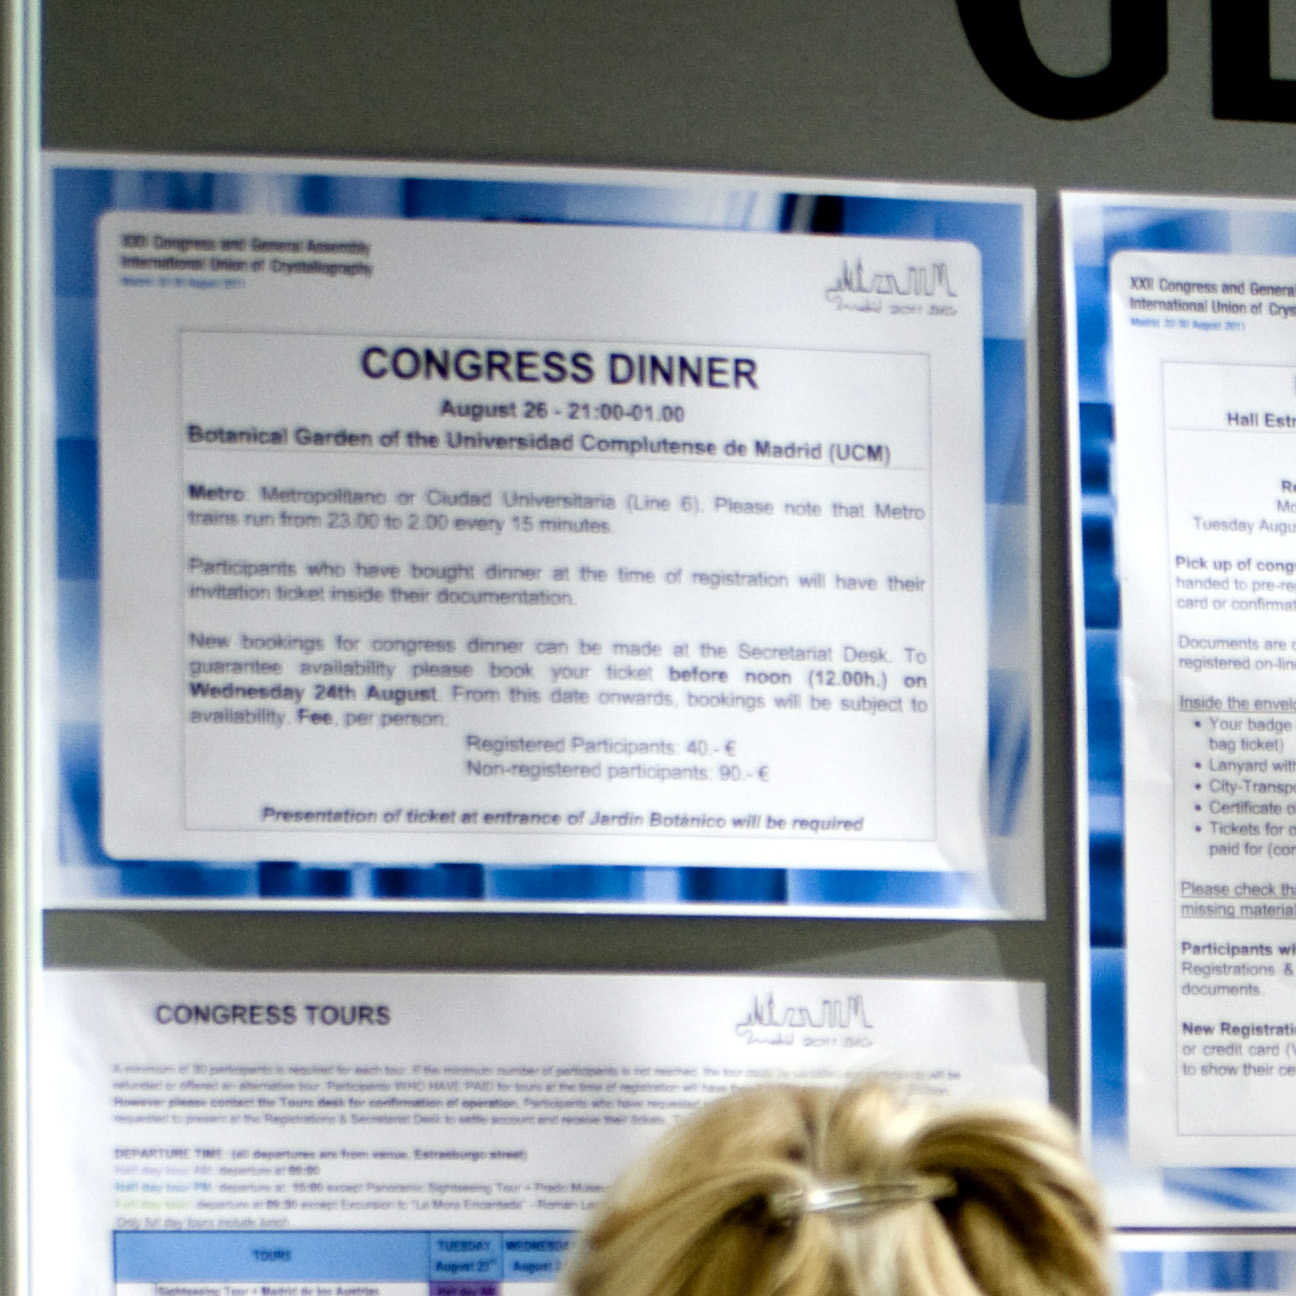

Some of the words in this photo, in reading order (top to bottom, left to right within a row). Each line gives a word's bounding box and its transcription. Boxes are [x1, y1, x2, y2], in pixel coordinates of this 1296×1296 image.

[360, 349, 595, 385] CONGRESS
[607, 355, 758, 389] DINNER
[439, 401, 516, 424] August
[523, 402, 548, 420] 26
[1227, 412, 1259, 428] Hall
[186, 425, 287, 446] Botanical
[294, 427, 372, 448] Garden
[379, 429, 400, 449] of
[405, 430, 439, 450] the
[446, 431, 573, 453] Universidad
[580, 435, 716, 462] Complutense
[723, 438, 747, 458] de
[754, 439, 821, 460] Madrid
[829, 441, 890, 466] (UCM)
[155, 1005, 296, 1025] CONGRESS
[305, 1005, 390, 1025] TOURS
